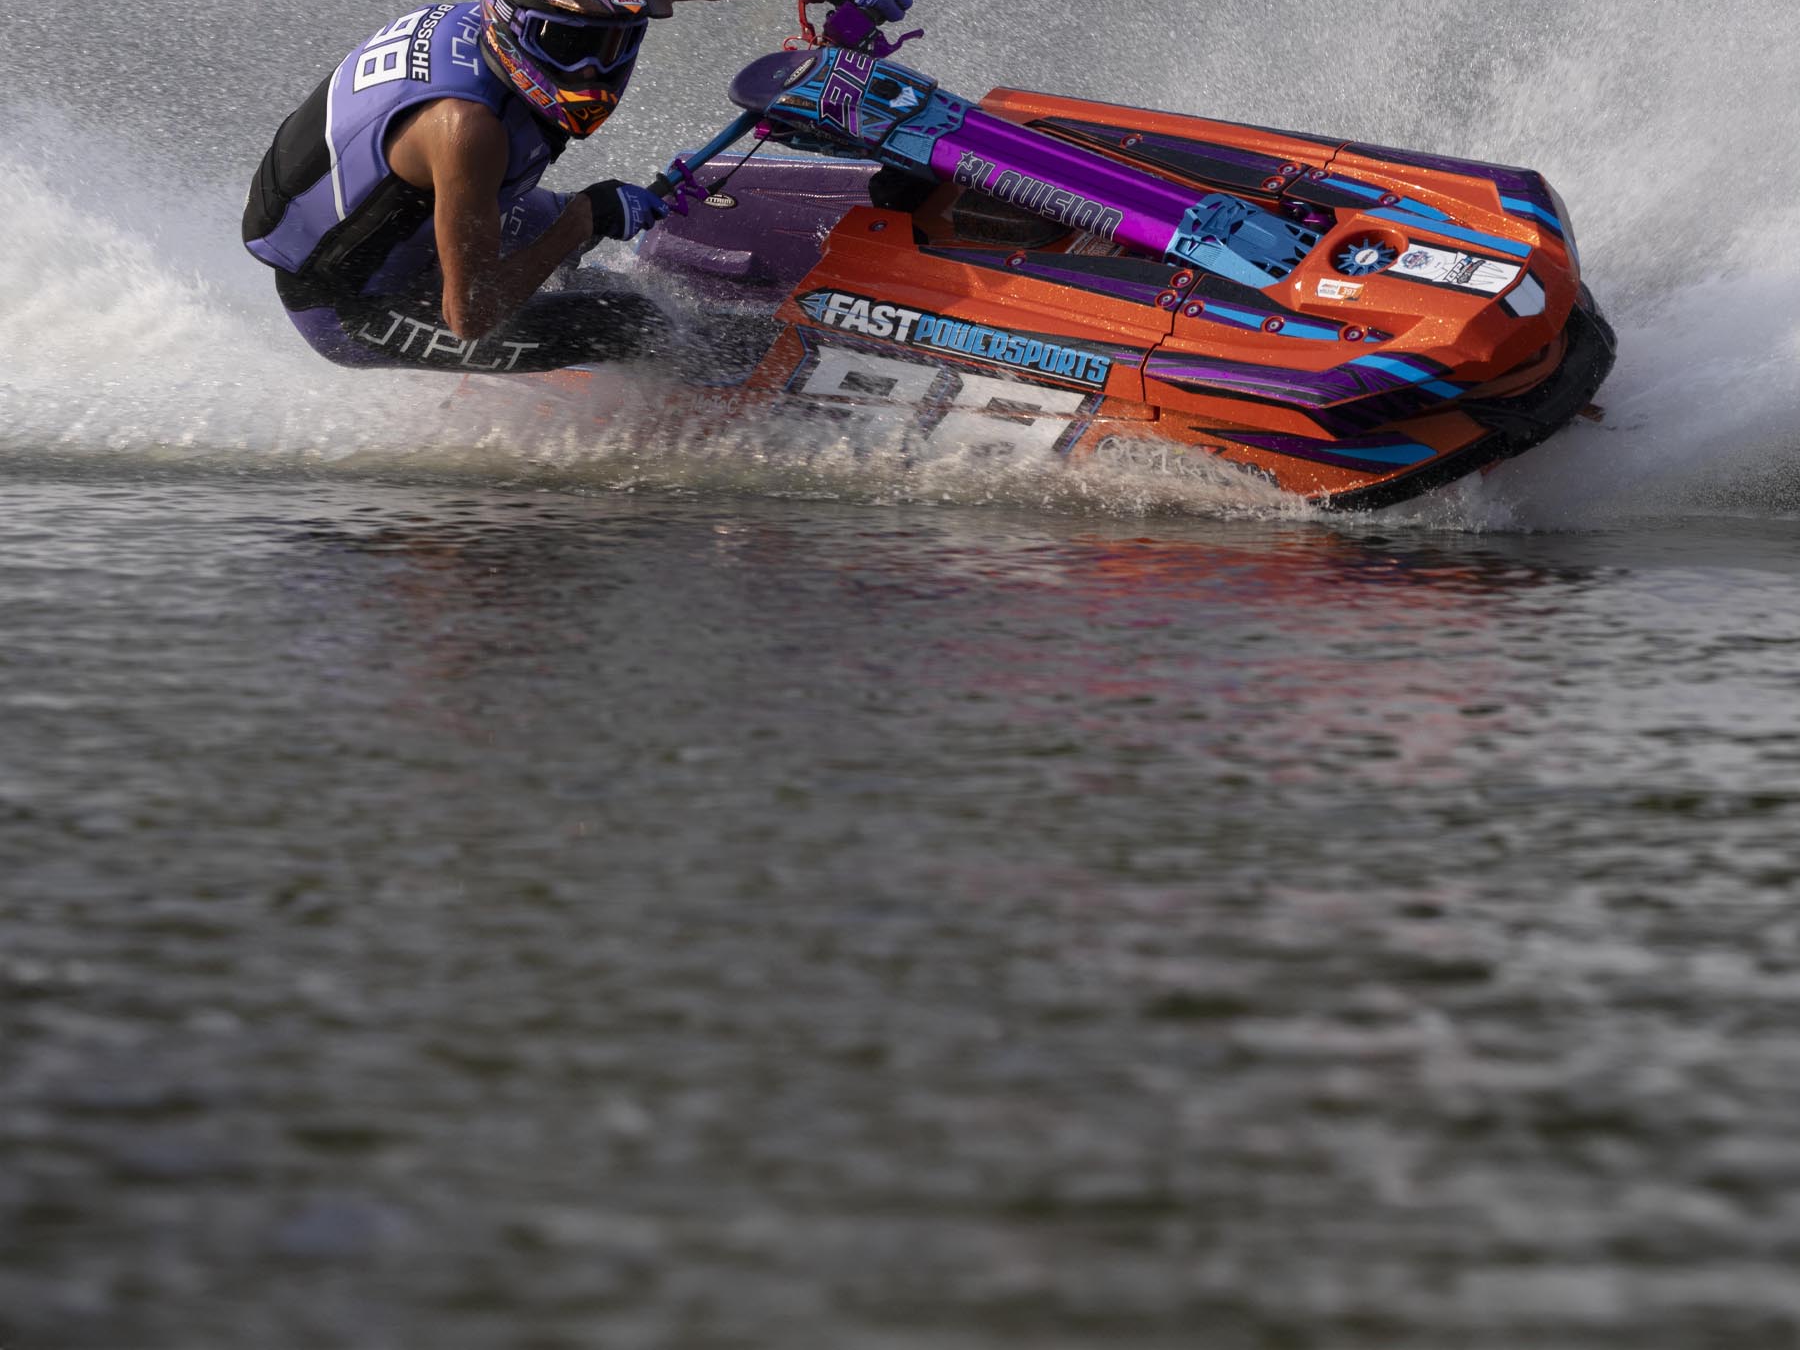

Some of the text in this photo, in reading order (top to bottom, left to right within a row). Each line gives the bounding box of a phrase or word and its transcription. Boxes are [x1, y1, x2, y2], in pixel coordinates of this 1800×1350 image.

[352, 7, 431, 93] 98
[413, 3, 456, 82] BOSSCHE
[952, 152, 1124, 241] BLOWSION
[356, 309, 540, 371] JTPLT
[822, 293, 1111, 383] FAST POWERSPORTS
